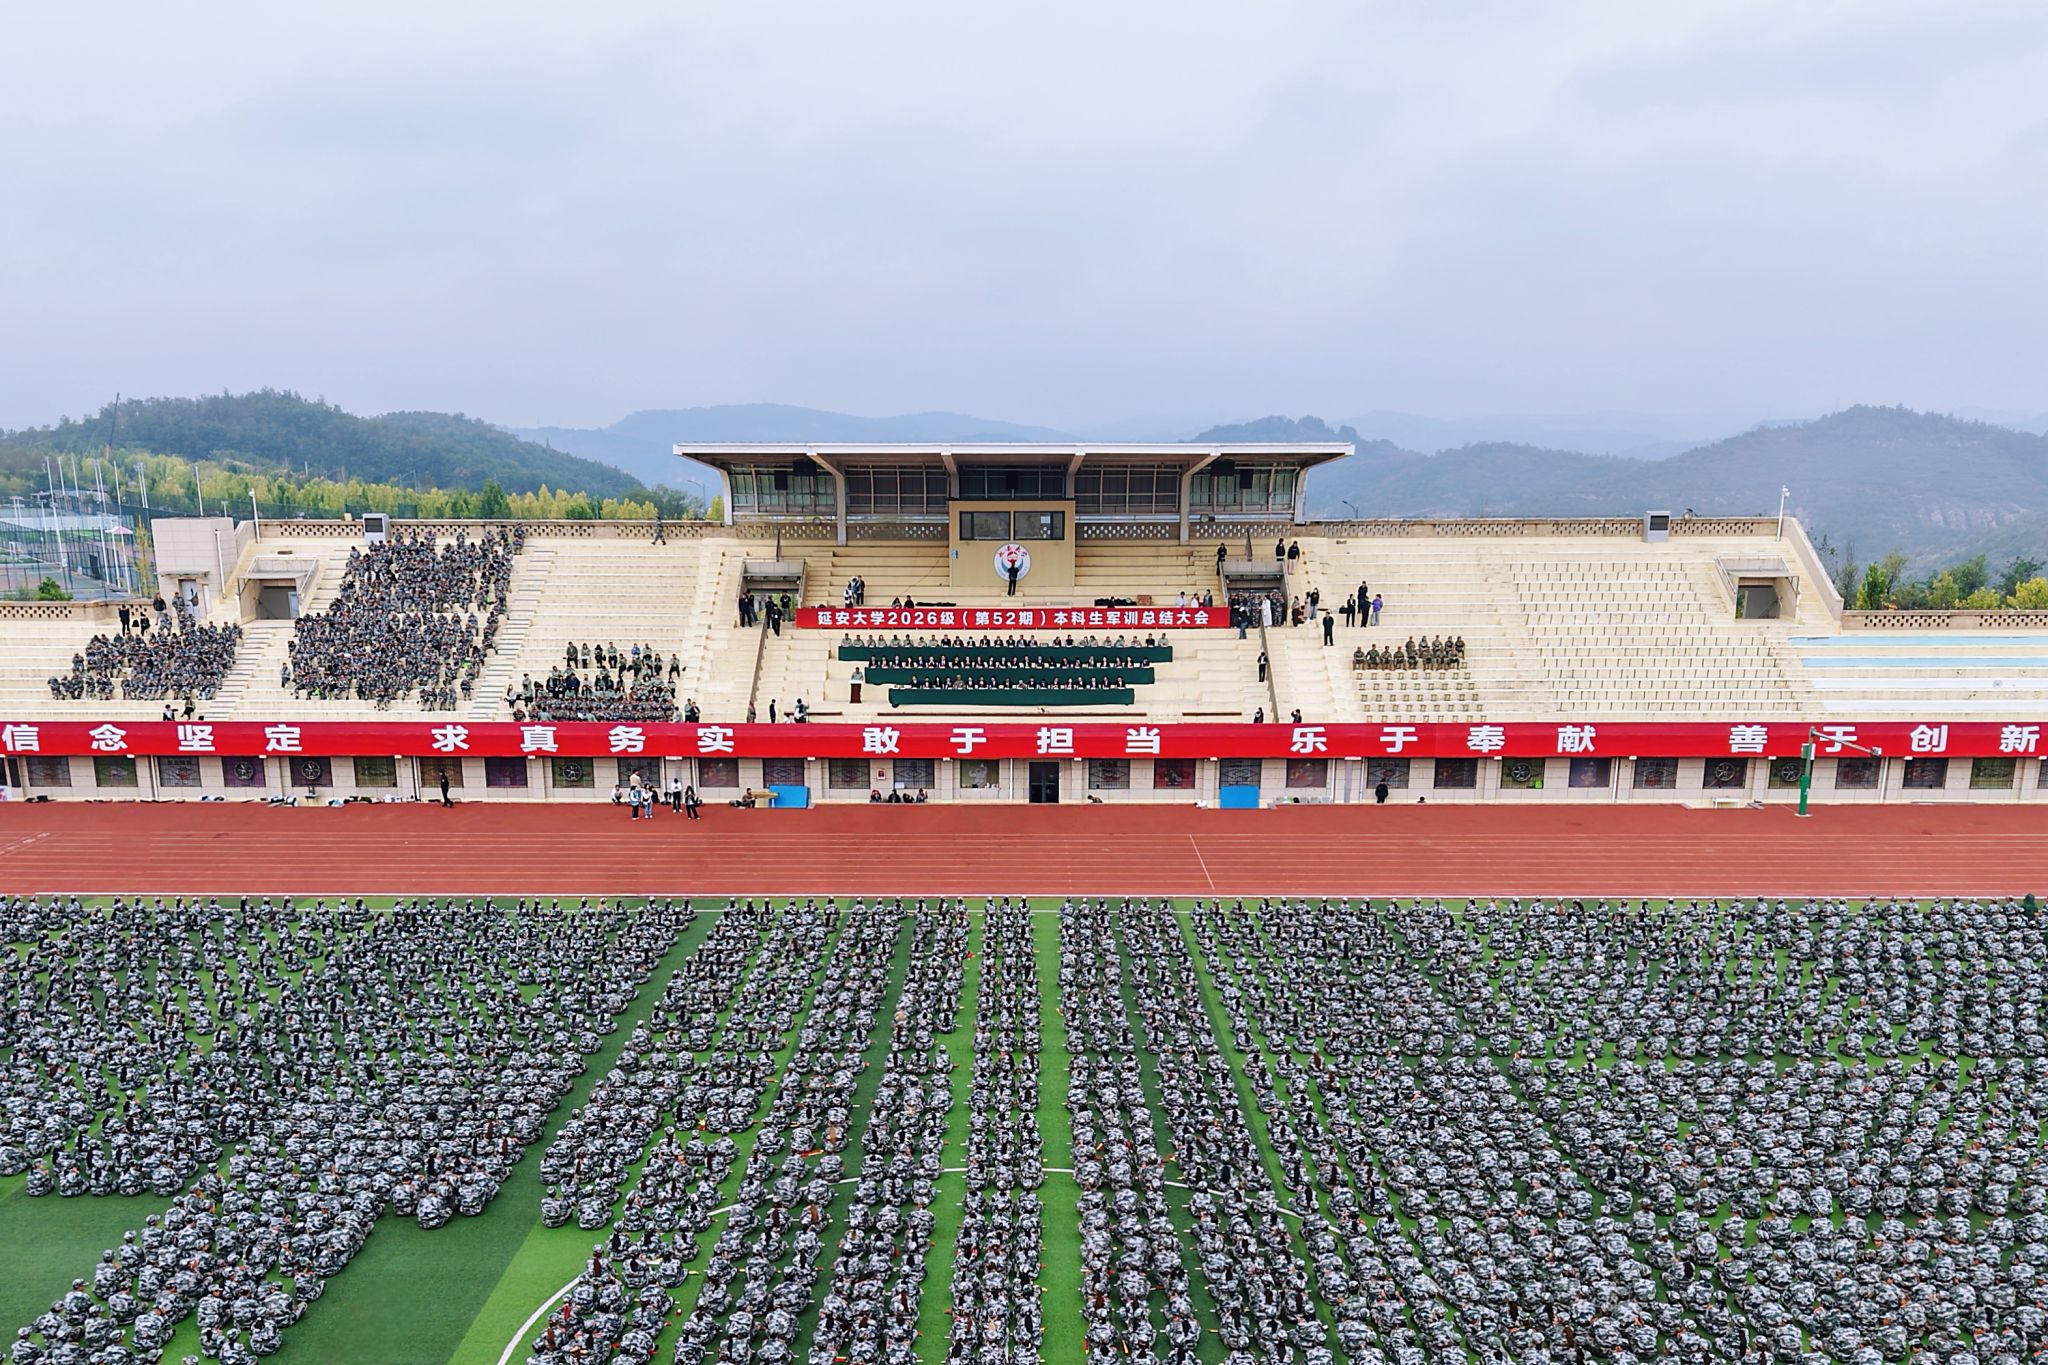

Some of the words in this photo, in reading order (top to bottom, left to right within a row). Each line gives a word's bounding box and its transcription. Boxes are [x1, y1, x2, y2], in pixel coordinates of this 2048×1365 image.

[2, 724, 303, 752] 信念坚定
[431, 725, 735, 753] 求真务实
[862, 727, 1160, 754] 敢于担当
[1290, 725, 1596, 753] 乐于奉献
[1728, 724, 2041, 753] 善于创新
